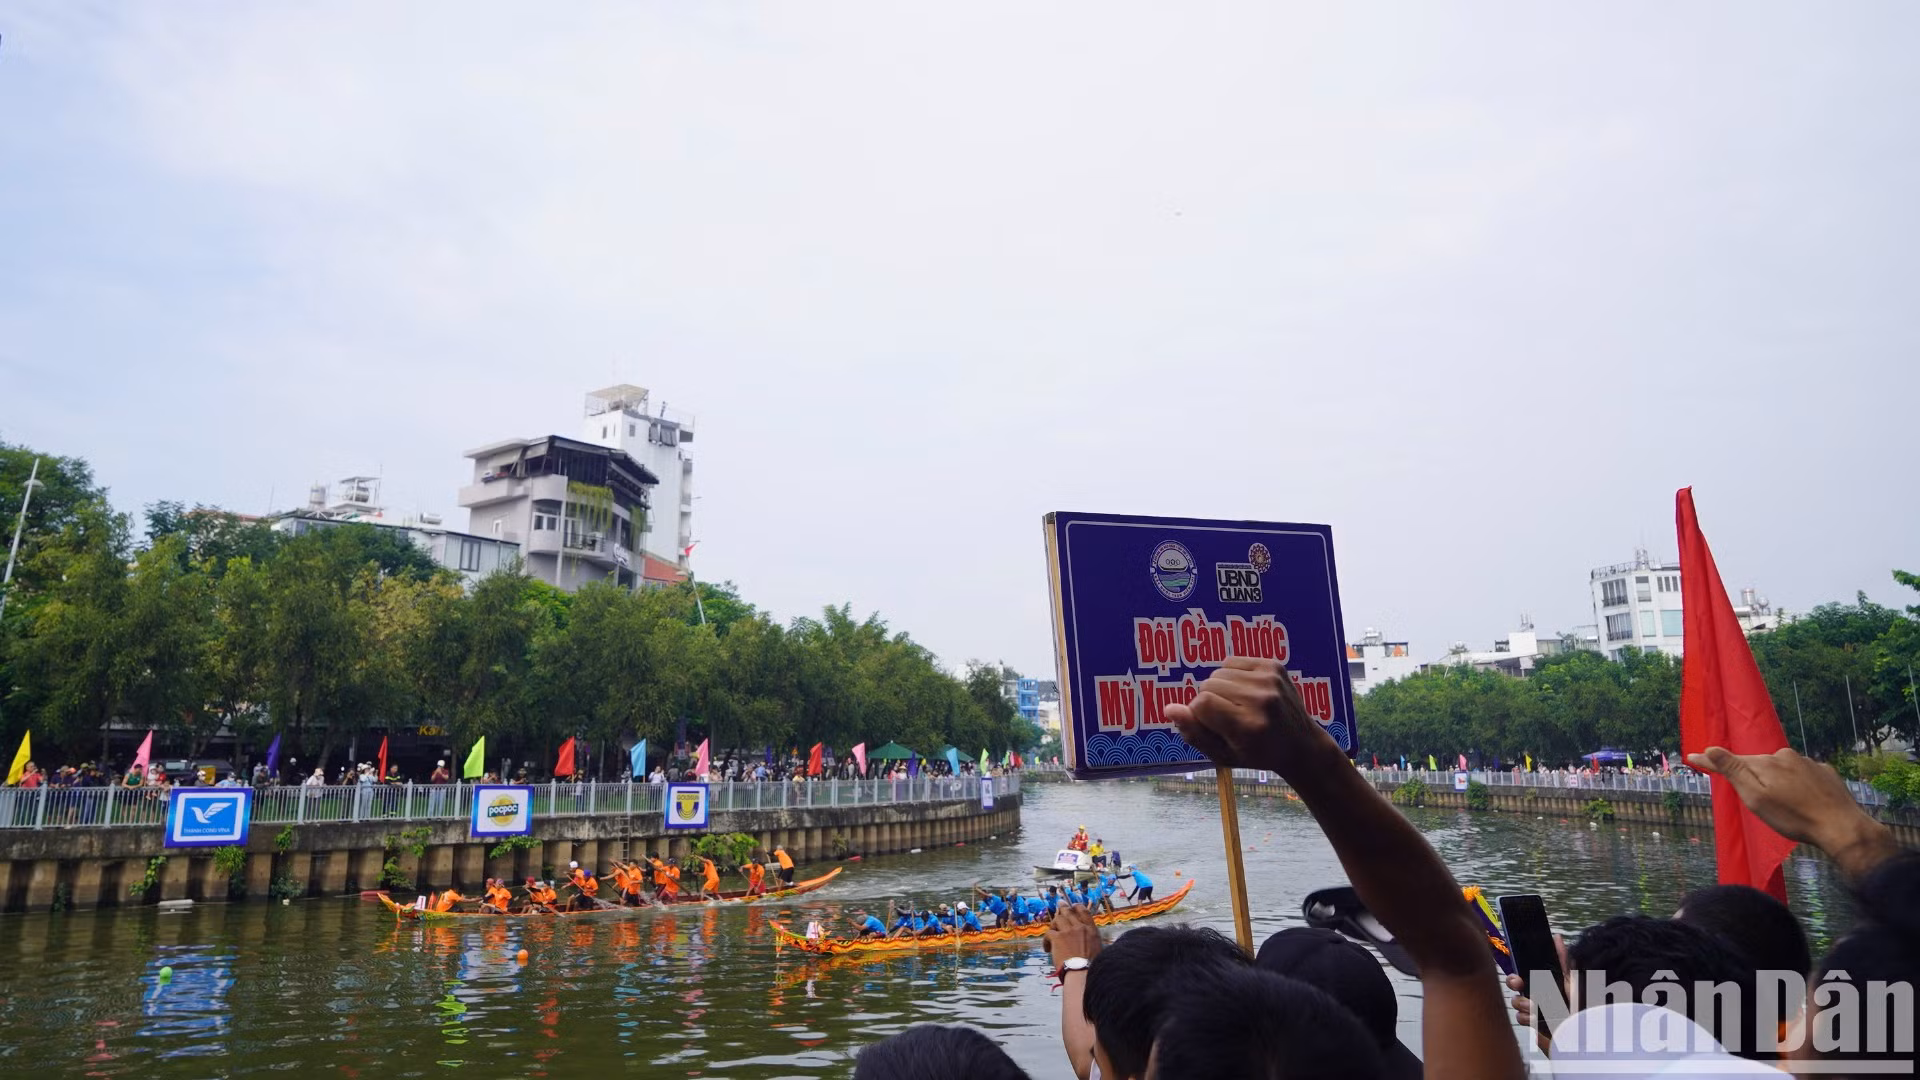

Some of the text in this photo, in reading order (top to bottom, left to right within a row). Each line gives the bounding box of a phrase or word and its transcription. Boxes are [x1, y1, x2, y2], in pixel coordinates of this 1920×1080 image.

[1217, 569, 1259, 587] UBND
[1138, 613, 1287, 671] Đội Cần Đước
[1099, 681, 1136, 730] Mỹ
